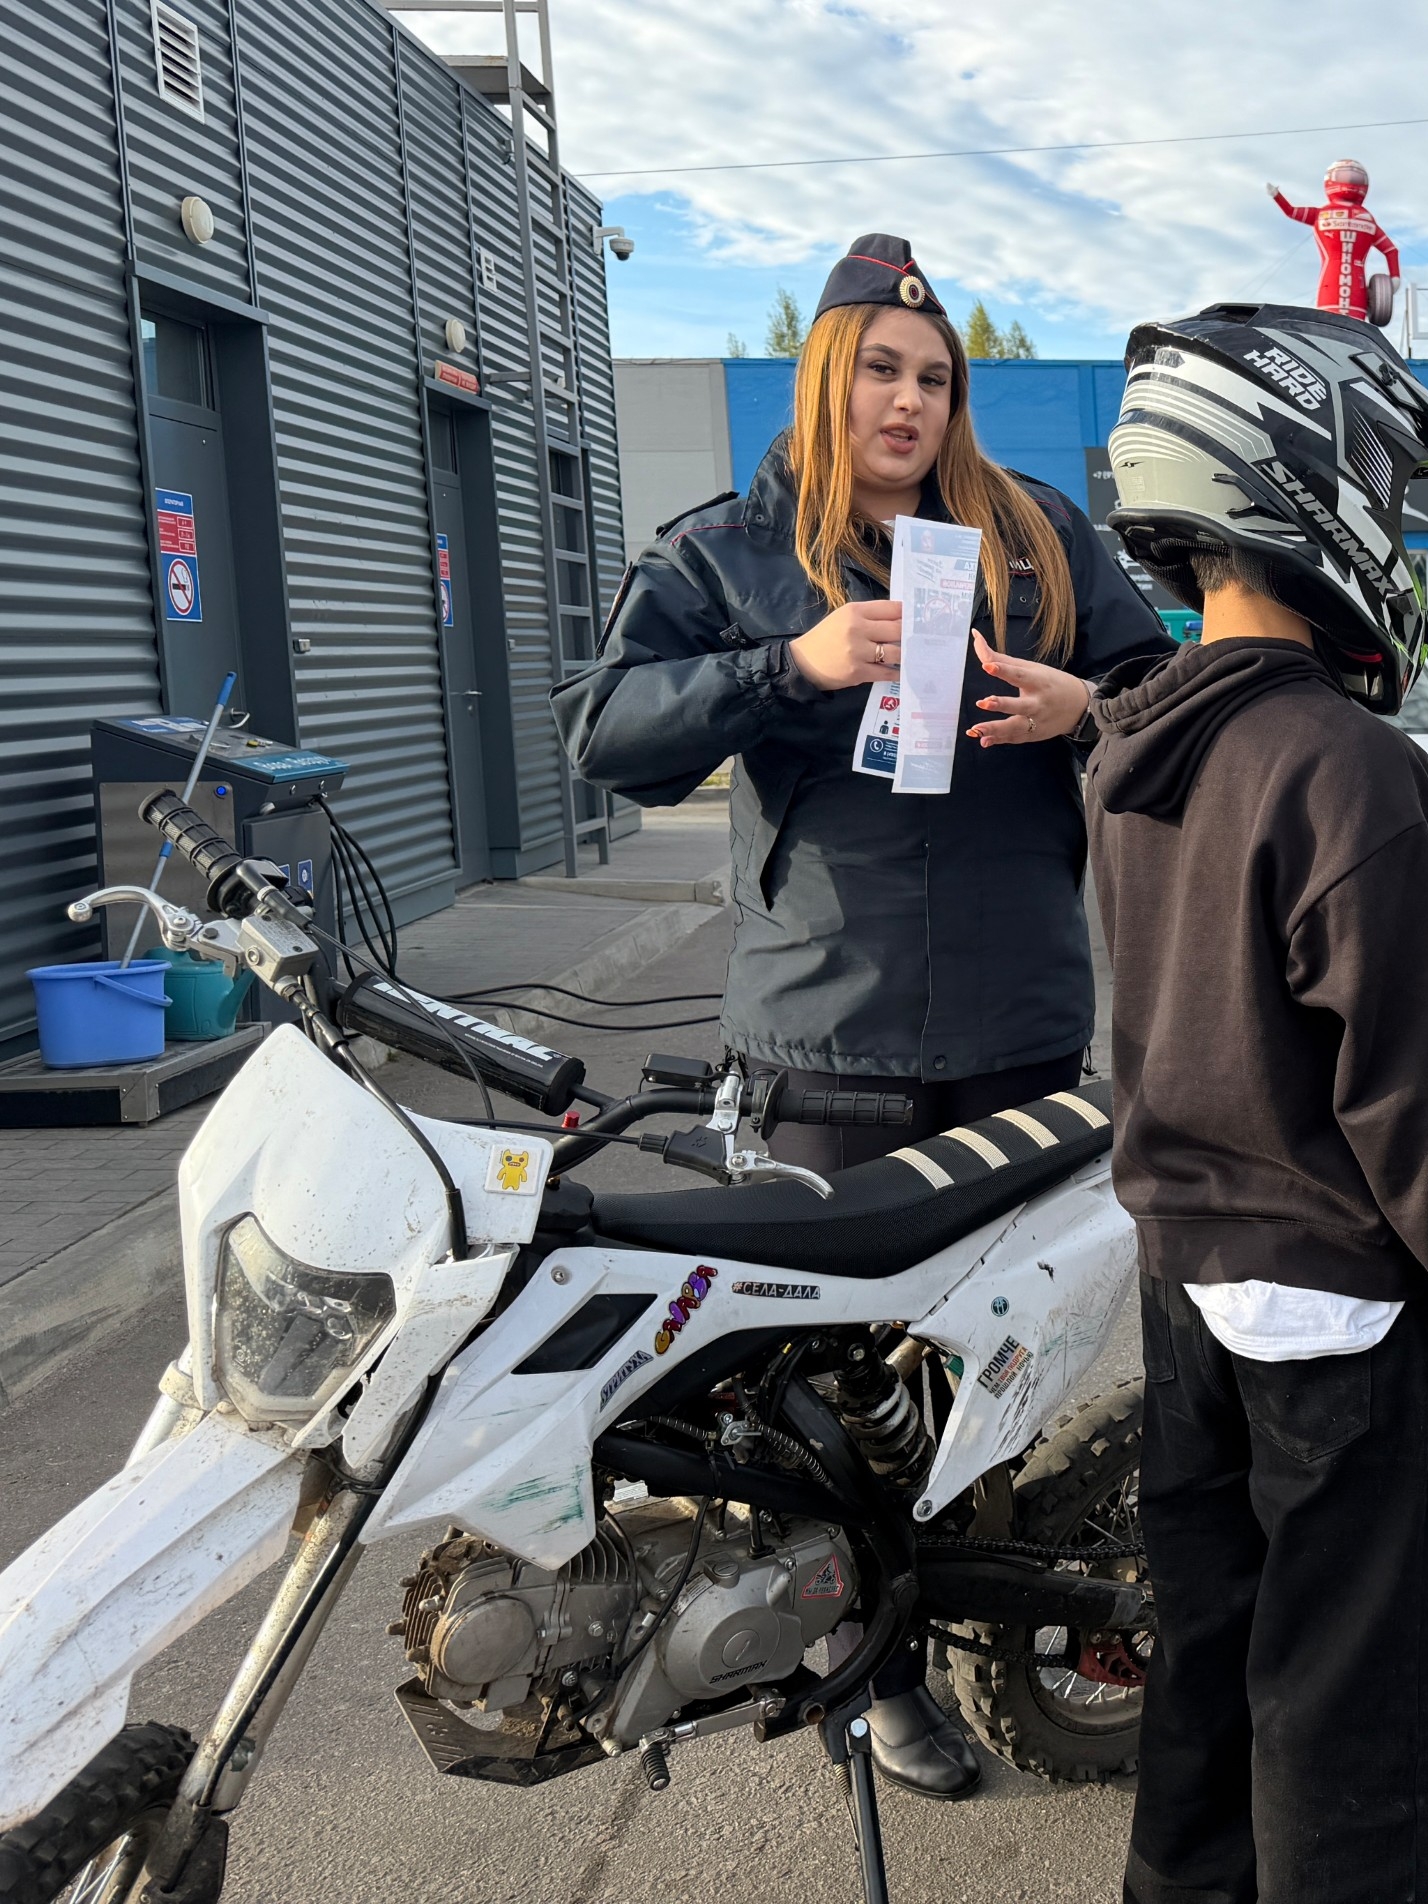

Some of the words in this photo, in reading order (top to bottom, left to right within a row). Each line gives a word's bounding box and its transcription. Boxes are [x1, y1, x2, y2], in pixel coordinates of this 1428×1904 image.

[1243, 350, 1321, 410] HARD
[1264, 347, 1327, 401] RIDE
[1261, 460, 1396, 597] SHARMAX
[732, 1282, 820, 1299] #СЕЛА-ДАЛА
[977, 1335, 1020, 1389] ГРОМЧЕ
[989, 1381, 1000, 1394] ЧЕМ
[709, 1660, 768, 1684] SHARMAX
